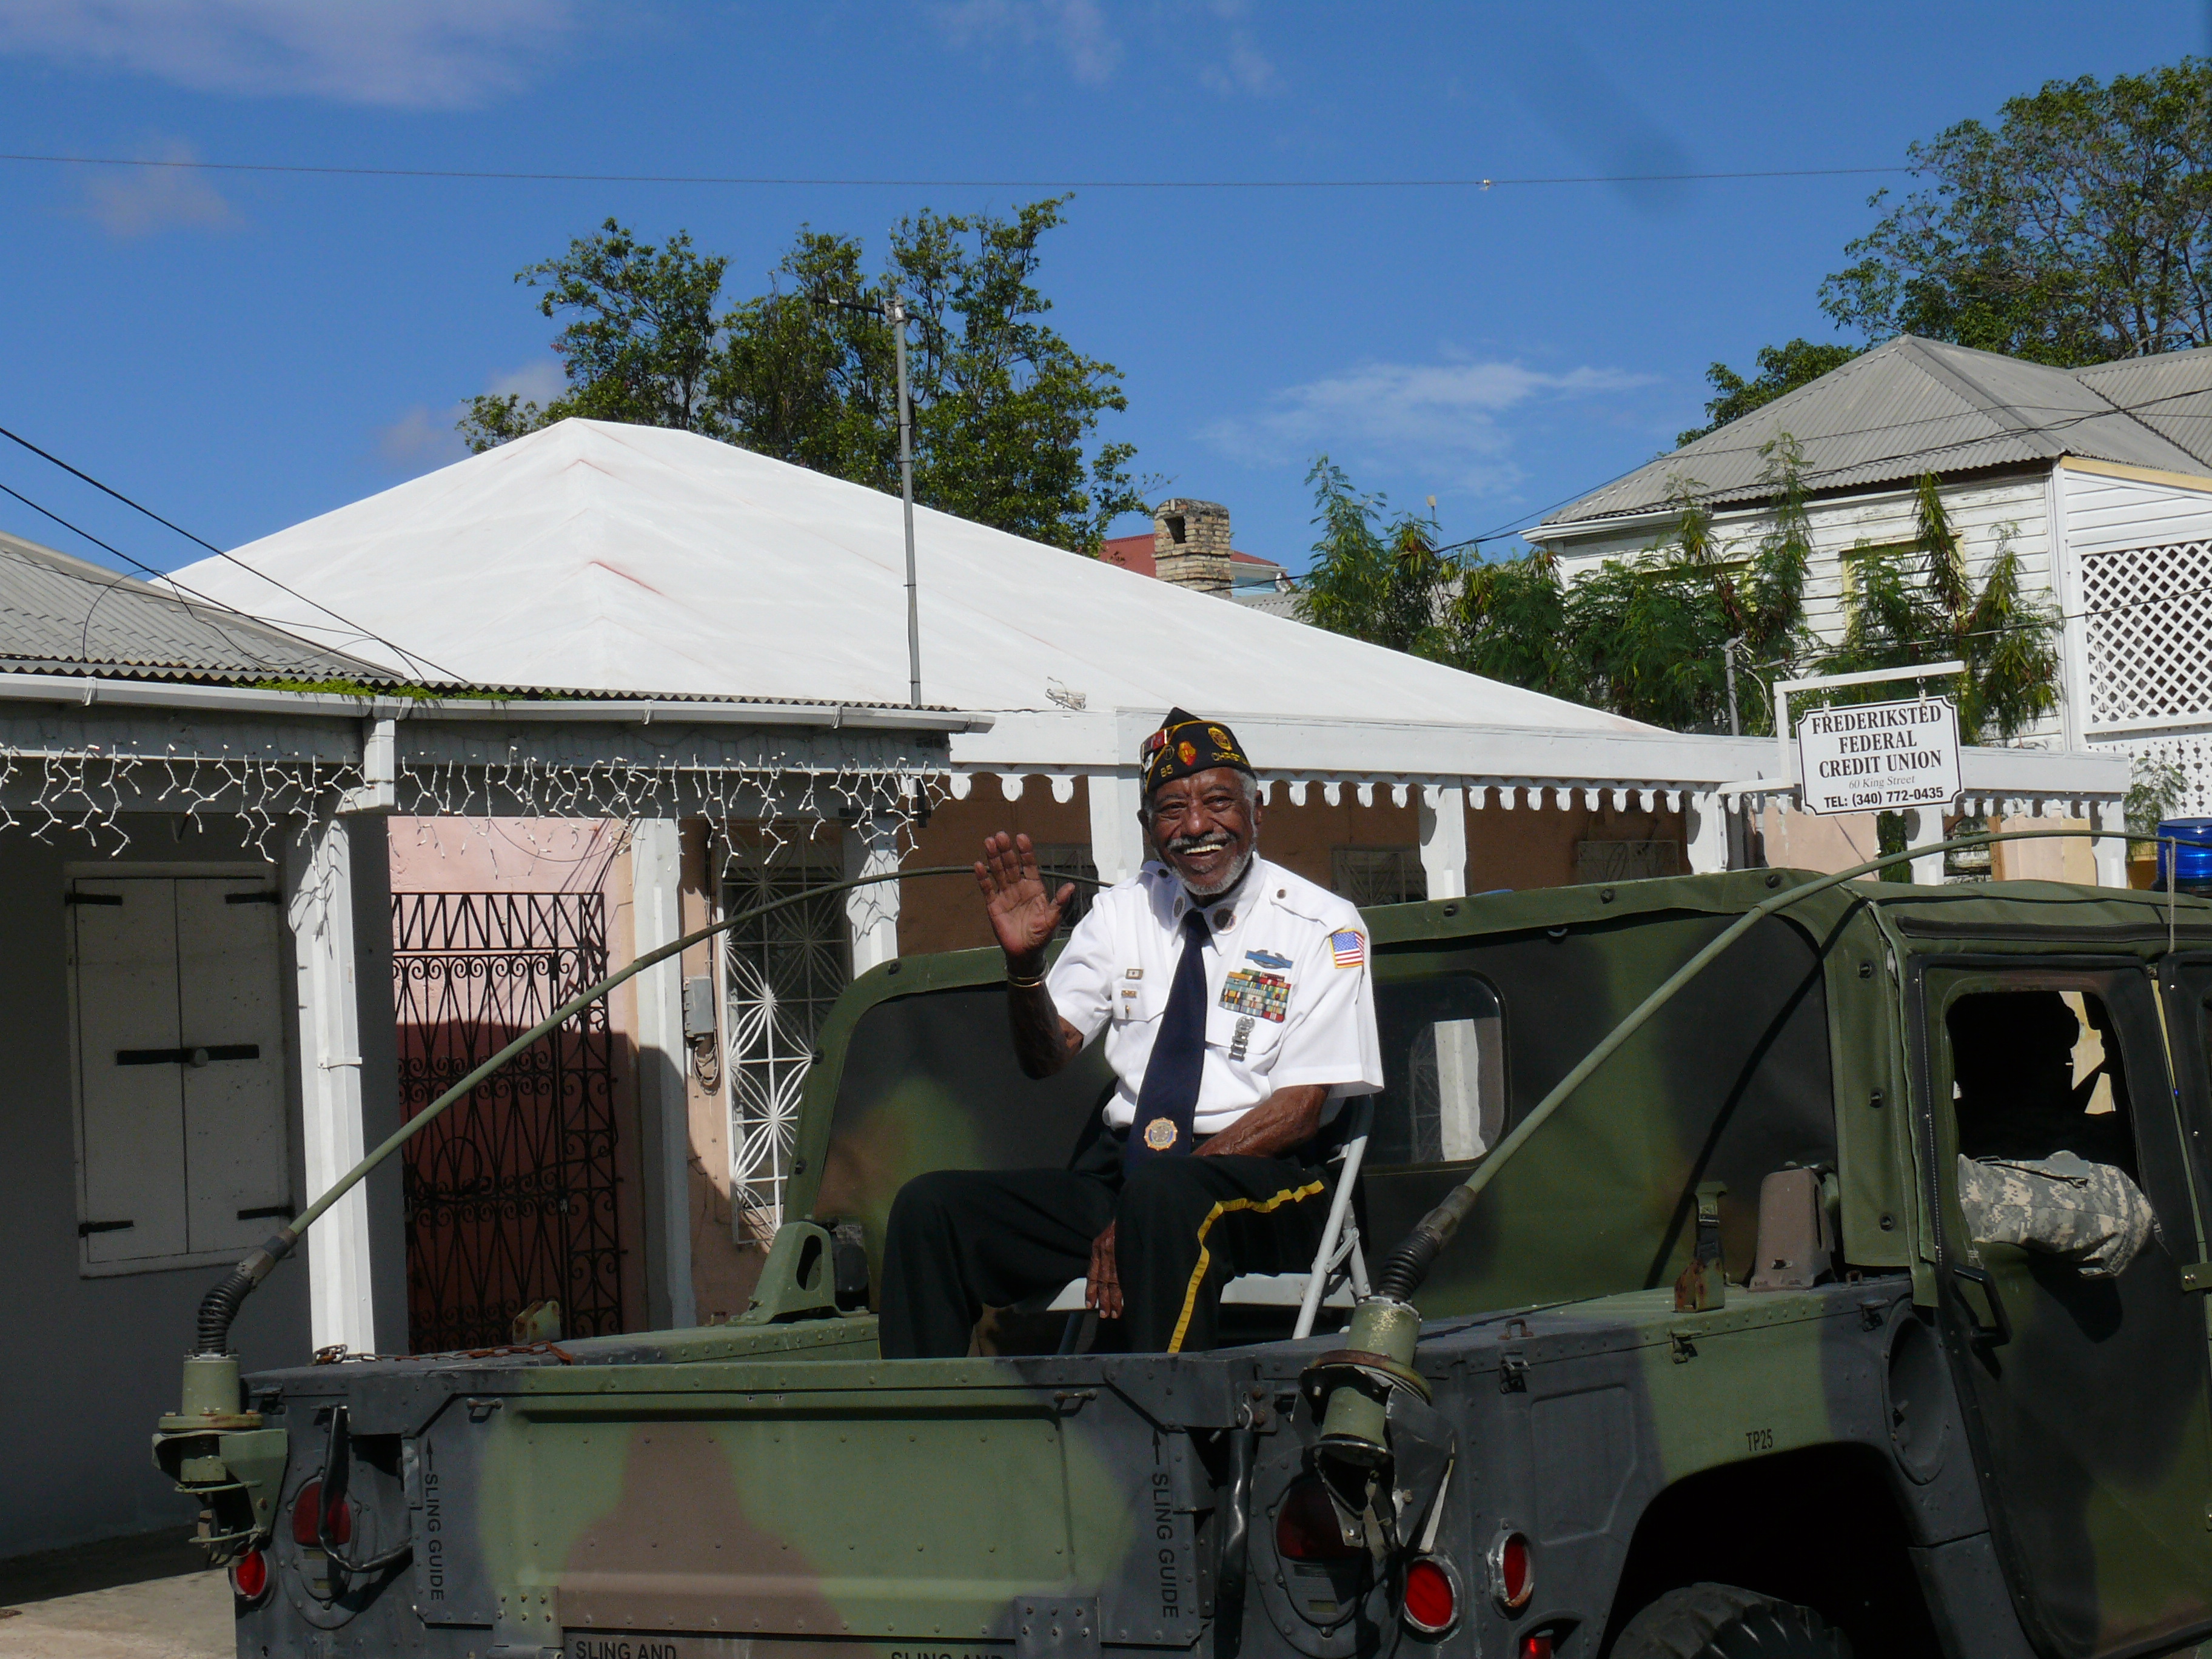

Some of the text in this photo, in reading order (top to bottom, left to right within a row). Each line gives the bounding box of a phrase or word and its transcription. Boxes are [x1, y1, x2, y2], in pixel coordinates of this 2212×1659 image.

[1811, 705, 1941, 734] FREDERIKSTED
[1838, 730, 1917, 754] FEDERAL
[1818, 749, 1942, 779] CREDIT UNION
[1848, 775, 1915, 789] 60 King Street
[1824, 786, 1944, 808] TEL: (340) 772-0435
[1746, 1428, 1773, 1451] TP25
[424, 1473, 444, 1601] SLING GUIDE
[1152, 1473, 1179, 1618] SLING GUIDE
[575, 1640, 677, 1659] SLING AND
